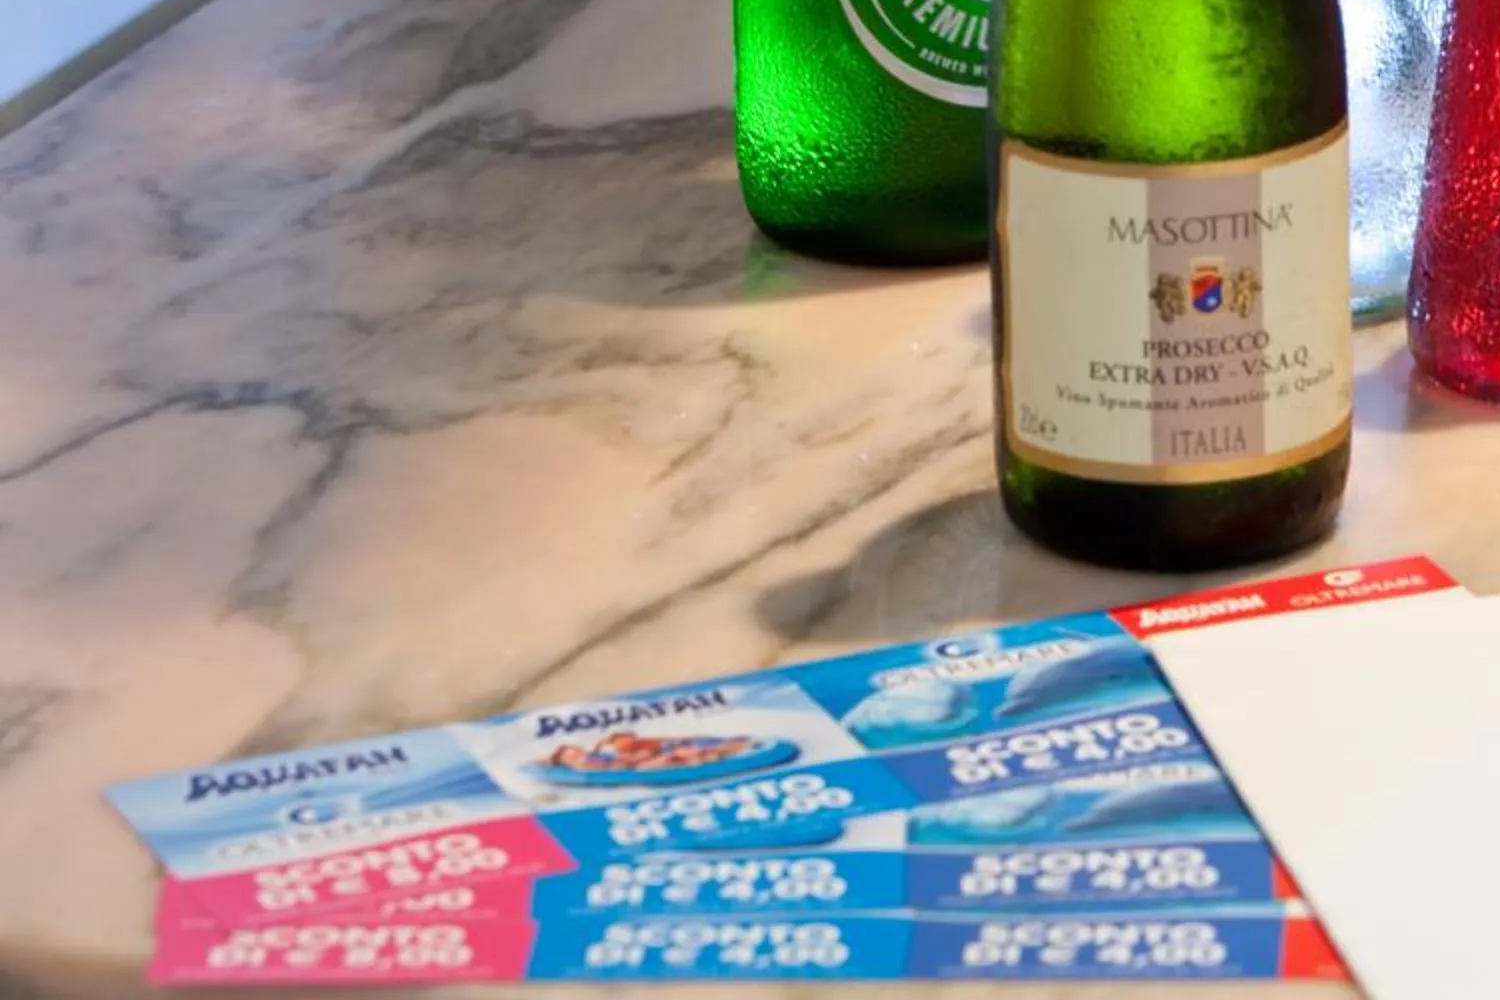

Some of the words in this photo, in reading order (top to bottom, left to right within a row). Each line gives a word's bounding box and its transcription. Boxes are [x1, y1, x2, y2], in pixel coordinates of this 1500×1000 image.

[1107, 203, 1293, 247] MASOTTINA
[1142, 330, 1270, 360] PROSECCO
[1089, 361, 1167, 387] EXTRA
[1174, 362, 1224, 386] DRY
[1169, 426, 1248, 457] ITALIA
[945, 713, 1162, 765] SCONTO
[604, 773, 828, 825] SCONTO
[253, 832, 484, 891] SCONTO
[601, 857, 838, 887] SCONTO
[971, 846, 1207, 876] SCONTO
[228, 924, 468, 950] SCONTO
[602, 922, 843, 948] SCONTO
[979, 921, 1218, 947] SCONTO
